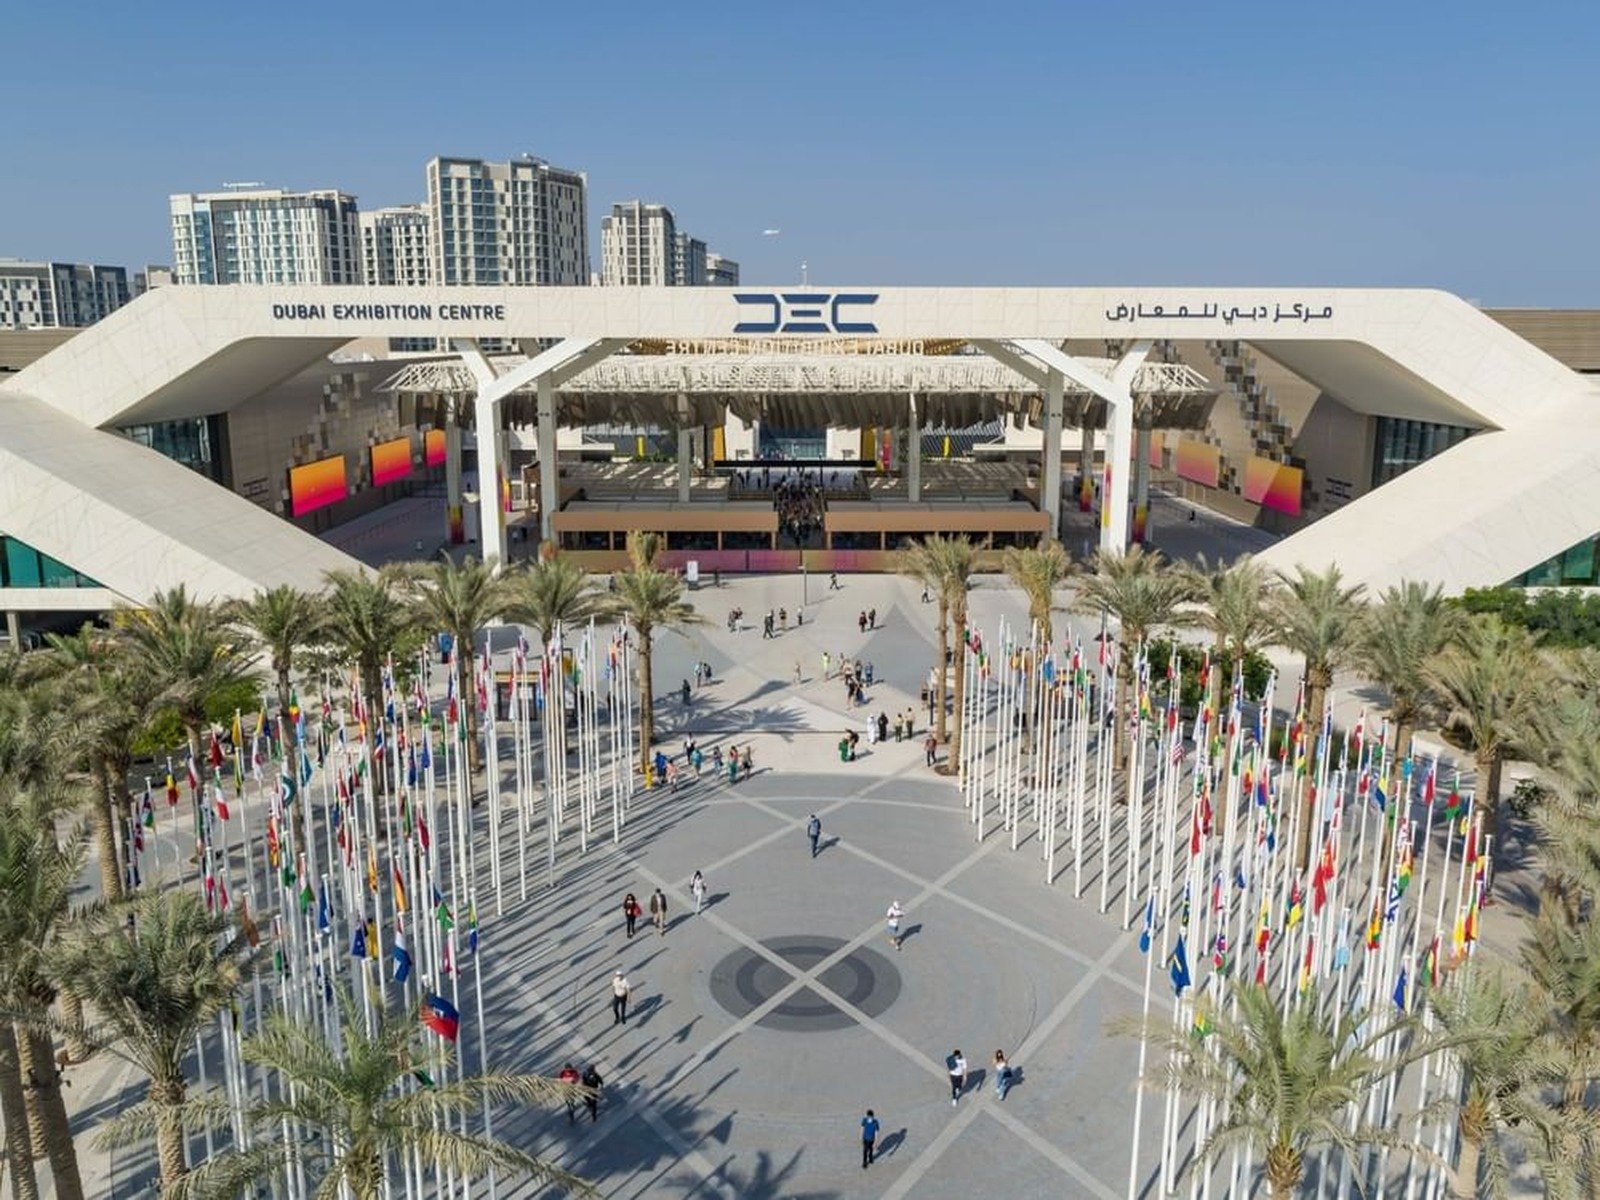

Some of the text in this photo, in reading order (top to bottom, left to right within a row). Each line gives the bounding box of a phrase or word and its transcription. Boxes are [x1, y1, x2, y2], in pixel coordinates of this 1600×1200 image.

[273, 304, 505, 320] DUBAI EXHIBITION CENTRE
[1106, 302, 1333, 326] مركز دبي للمعارض
